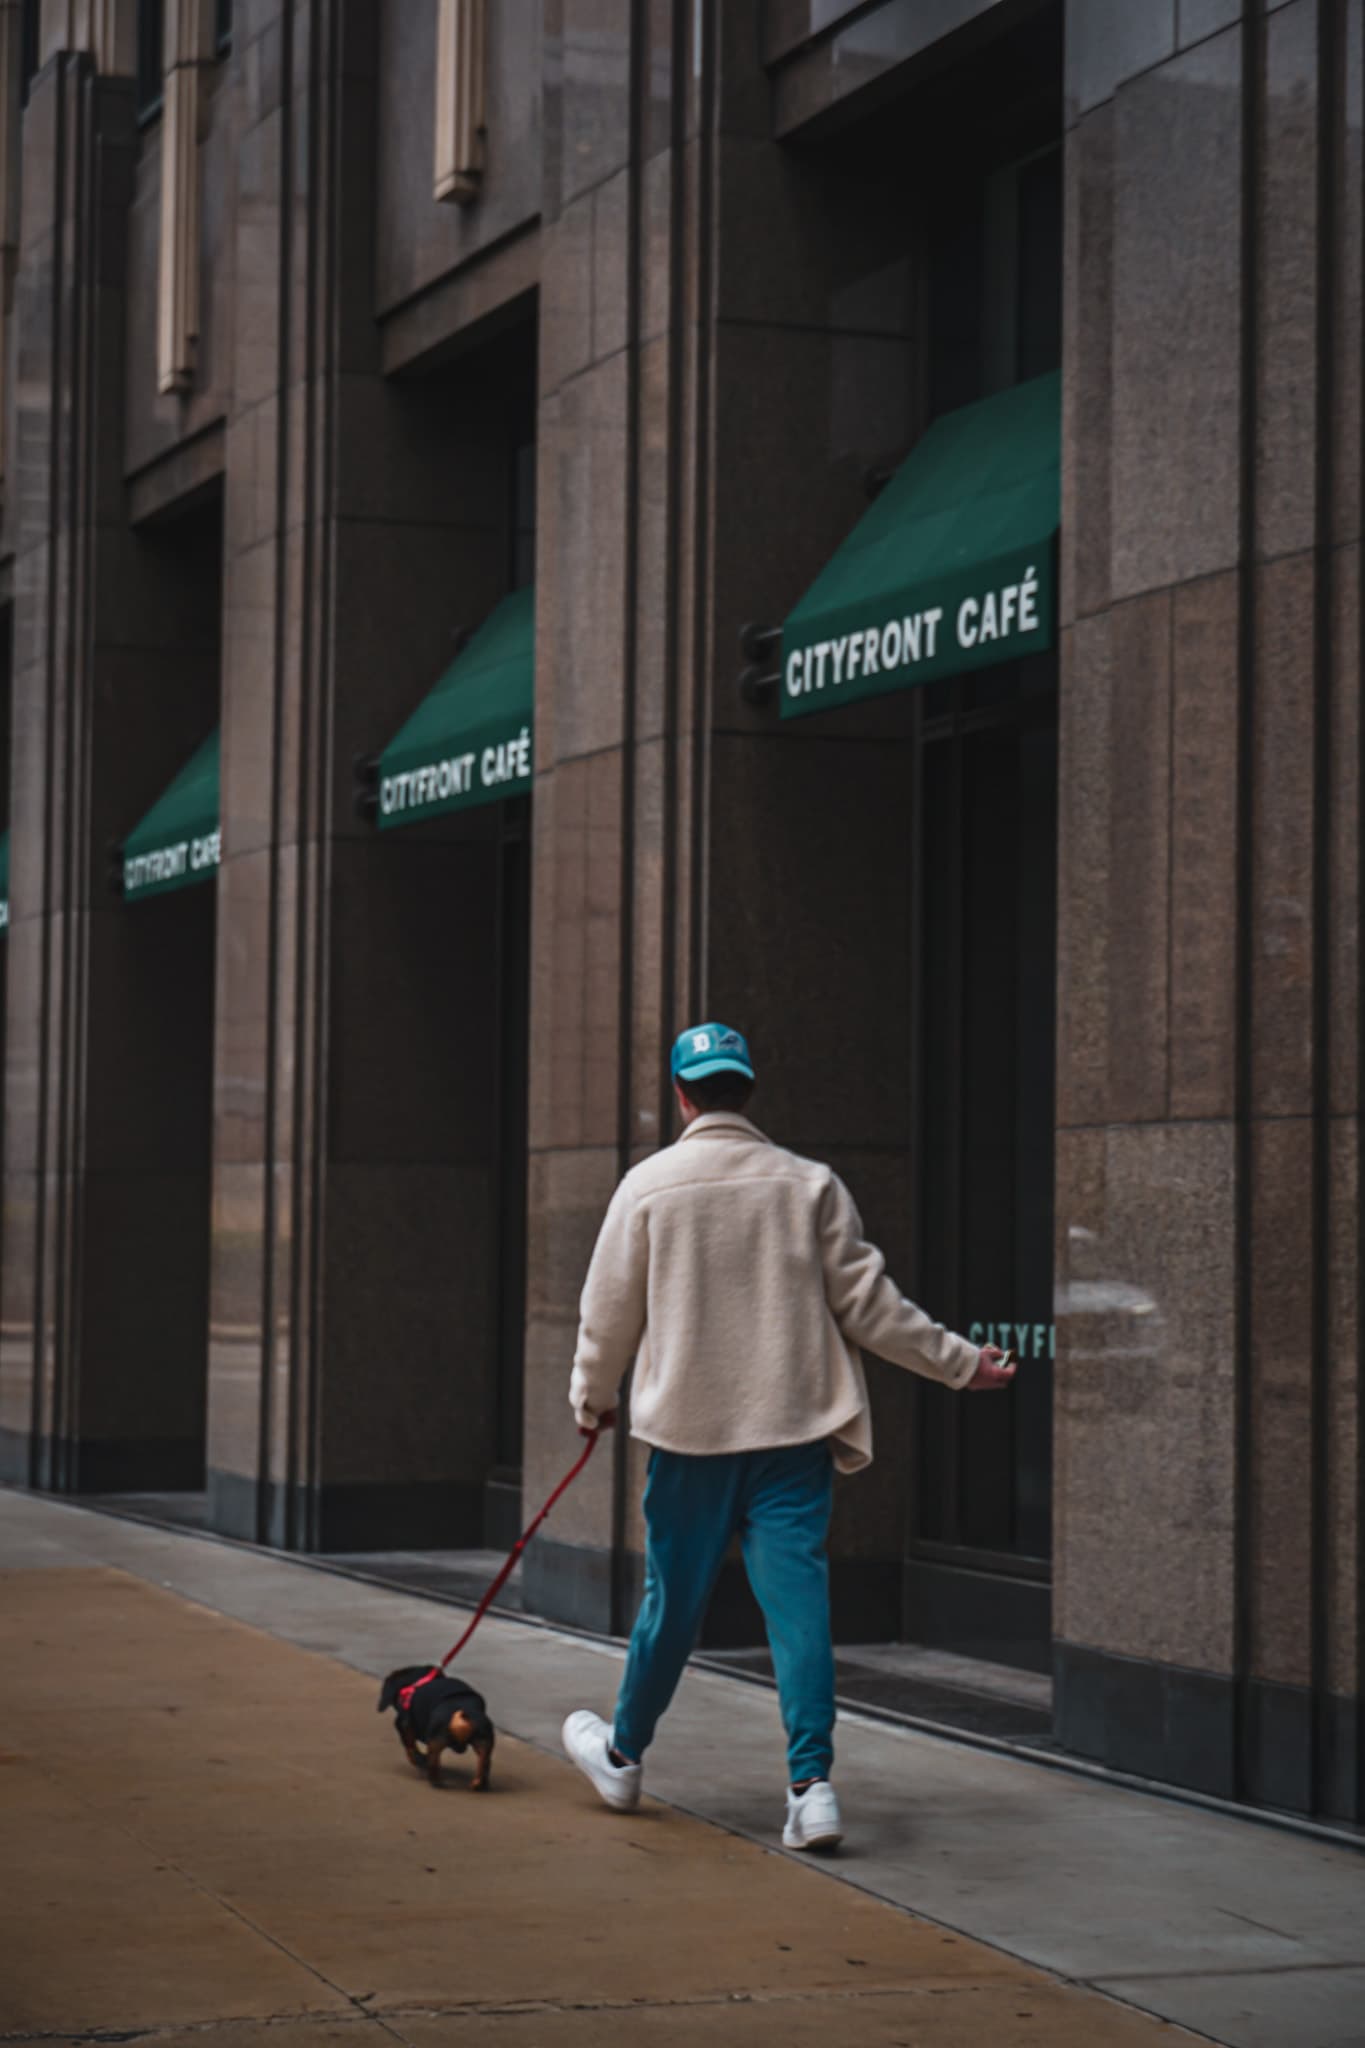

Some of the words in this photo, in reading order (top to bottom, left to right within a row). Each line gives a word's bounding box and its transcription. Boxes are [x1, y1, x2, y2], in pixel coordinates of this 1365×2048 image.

[786, 606, 943, 697] CITYFRONT
[957, 566, 1039, 648] CAFÉ
[380, 752, 475, 815] CITYFRONT
[481, 726, 530, 786] CAFÉ
